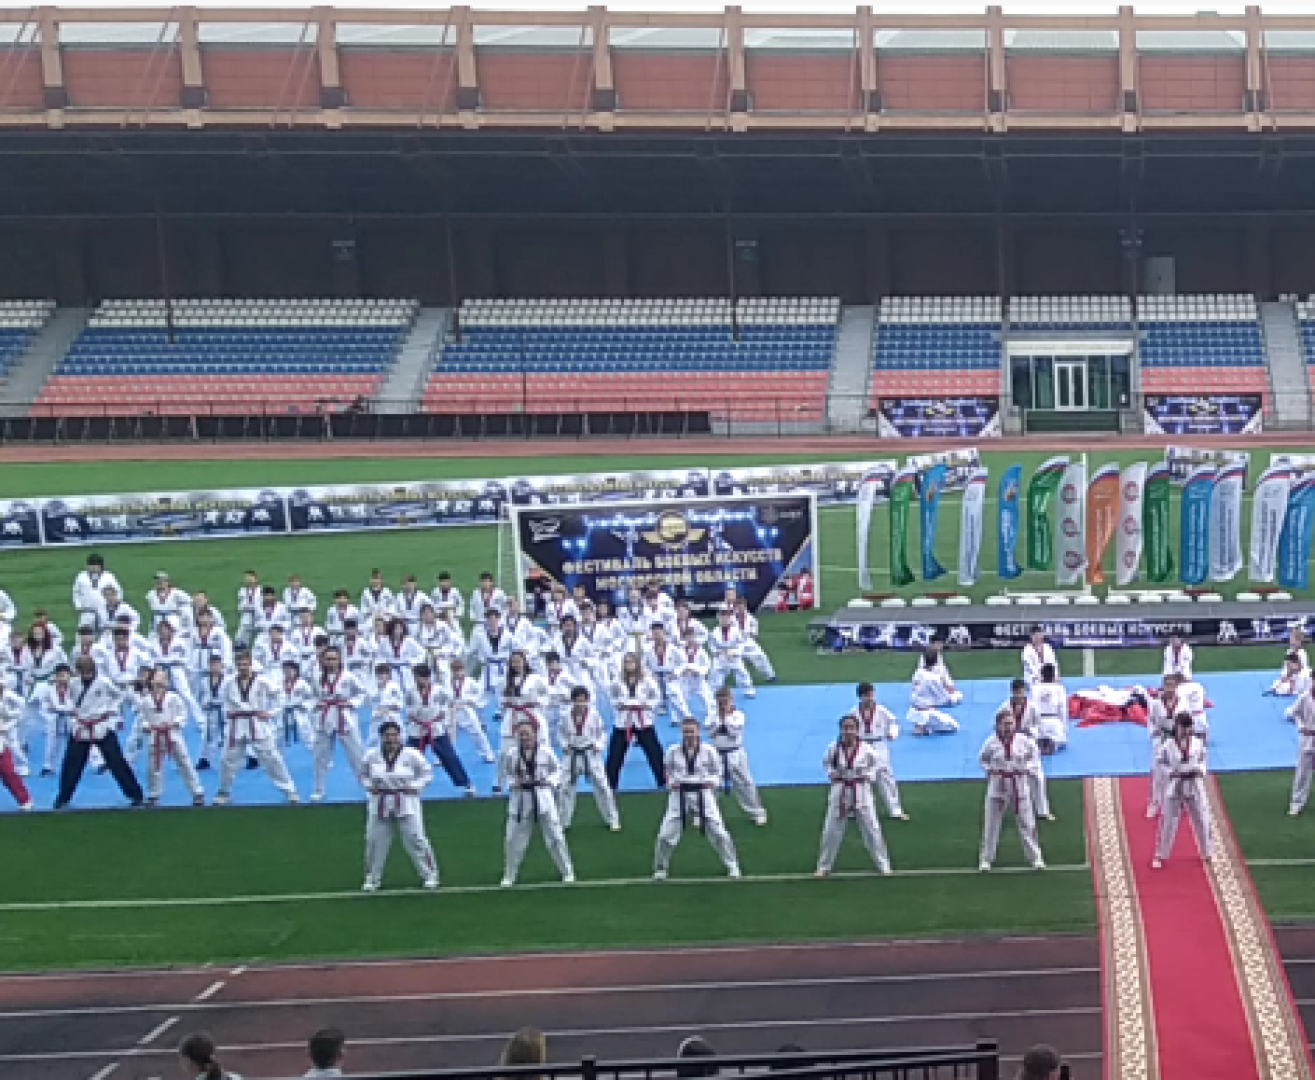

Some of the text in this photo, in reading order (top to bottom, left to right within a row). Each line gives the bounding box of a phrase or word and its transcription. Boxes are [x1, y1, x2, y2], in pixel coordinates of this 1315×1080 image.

[561, 547, 783, 575] ФЕСТИВАЛЬ БОЕВЫХ ИСКУССТВ
[695, 567, 759, 583] ОБЛАСТИ
